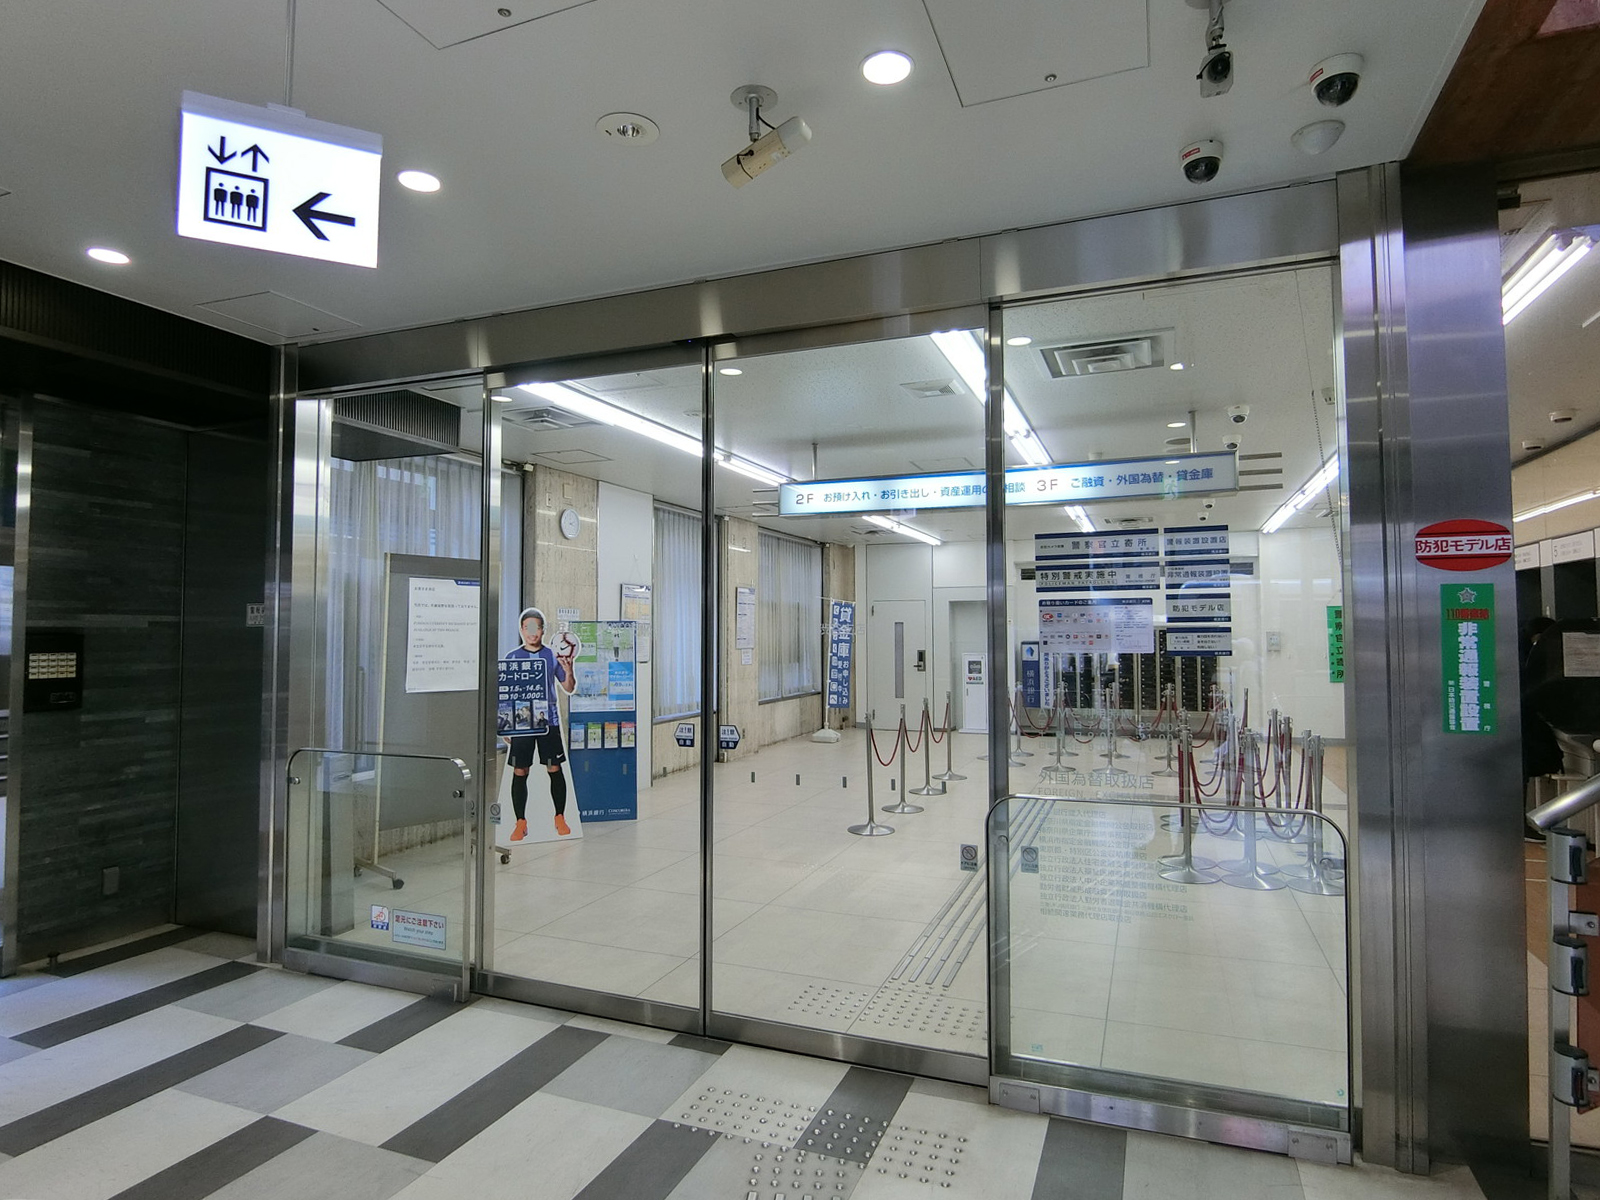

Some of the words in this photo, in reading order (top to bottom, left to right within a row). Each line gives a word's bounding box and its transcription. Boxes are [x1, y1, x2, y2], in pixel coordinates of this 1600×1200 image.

[795, 493, 814, 505] 2F
[1036, 479, 1058, 492] 3F
[1415, 537, 1511, 553] 防犯モデル店
[838, 606, 853, 658] 貸金庫
[498, 661, 543, 671] 横浜銀行
[498, 672, 543, 681] カードローン
[1038, 771, 1155, 790] 外国為替取扱店
[1038, 787, 1084, 798] FOREIGN
